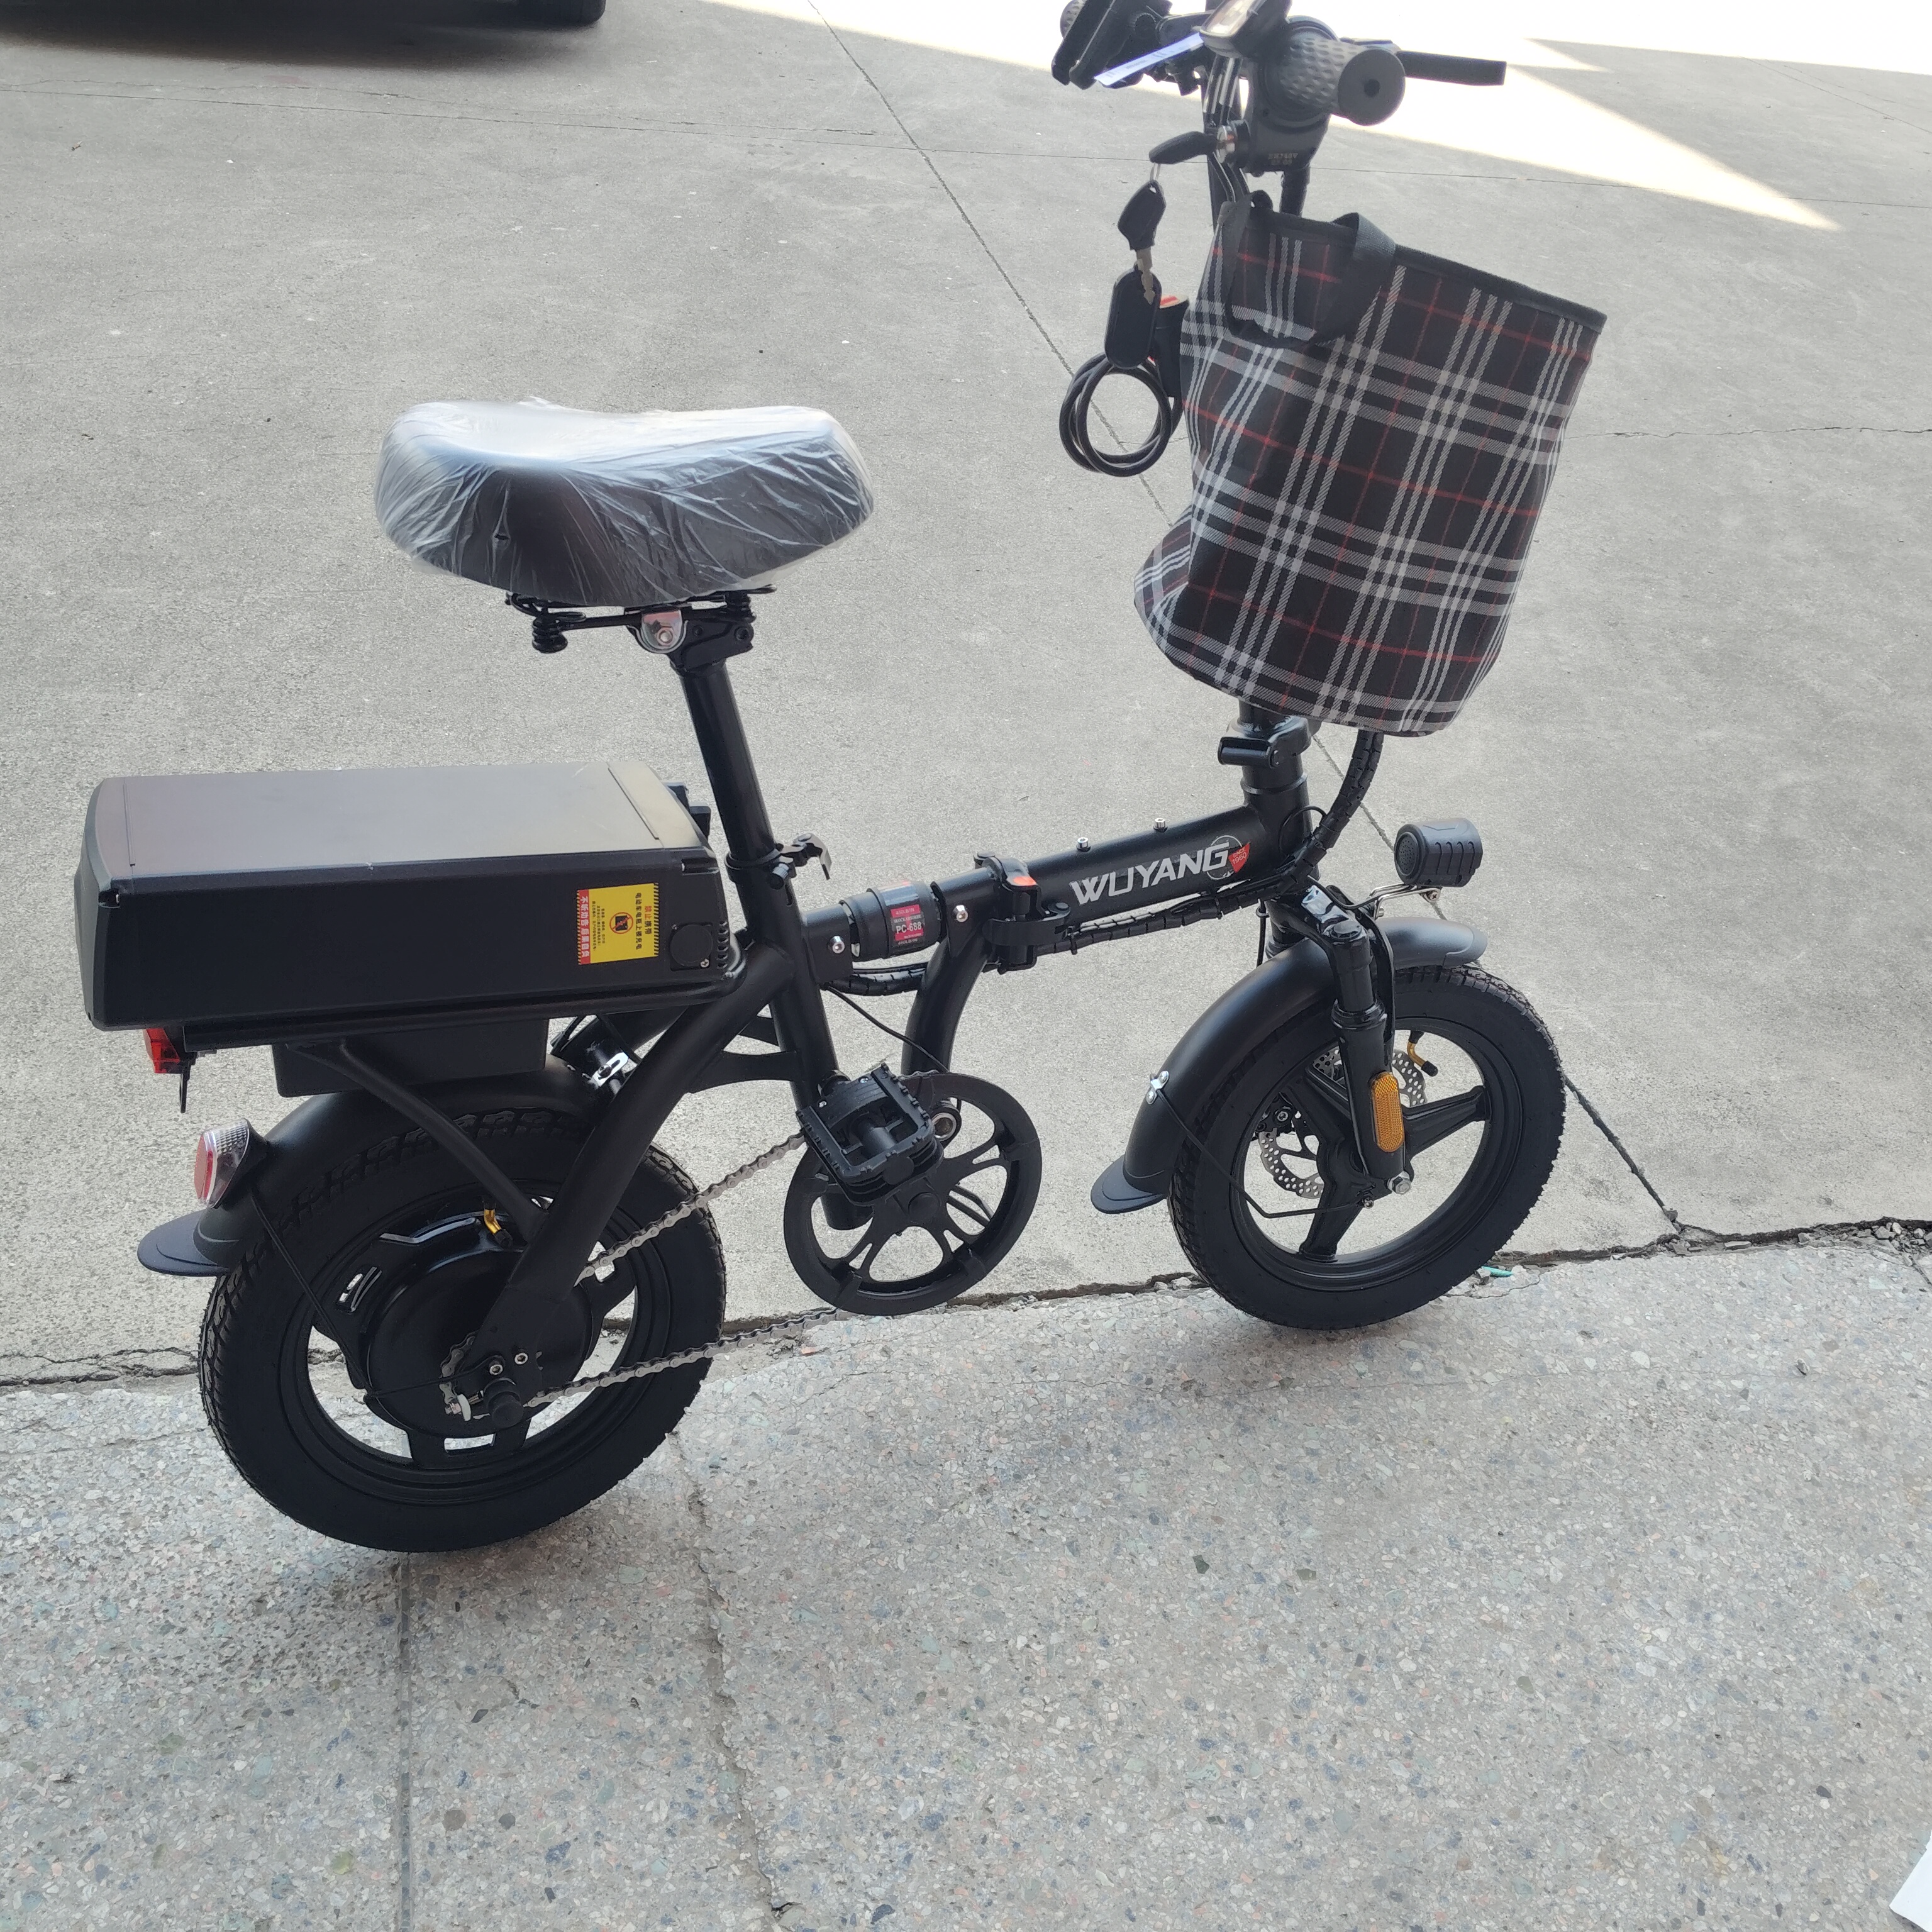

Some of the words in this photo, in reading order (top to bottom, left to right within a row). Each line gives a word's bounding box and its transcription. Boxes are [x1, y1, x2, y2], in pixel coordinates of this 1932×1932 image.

[1232, 852, 1247, 865] 1960
[1069, 842, 1230, 905] WUYANG
[896, 921, 922, 934] PC-688
[581, 928, 590, 958] 后果自负
